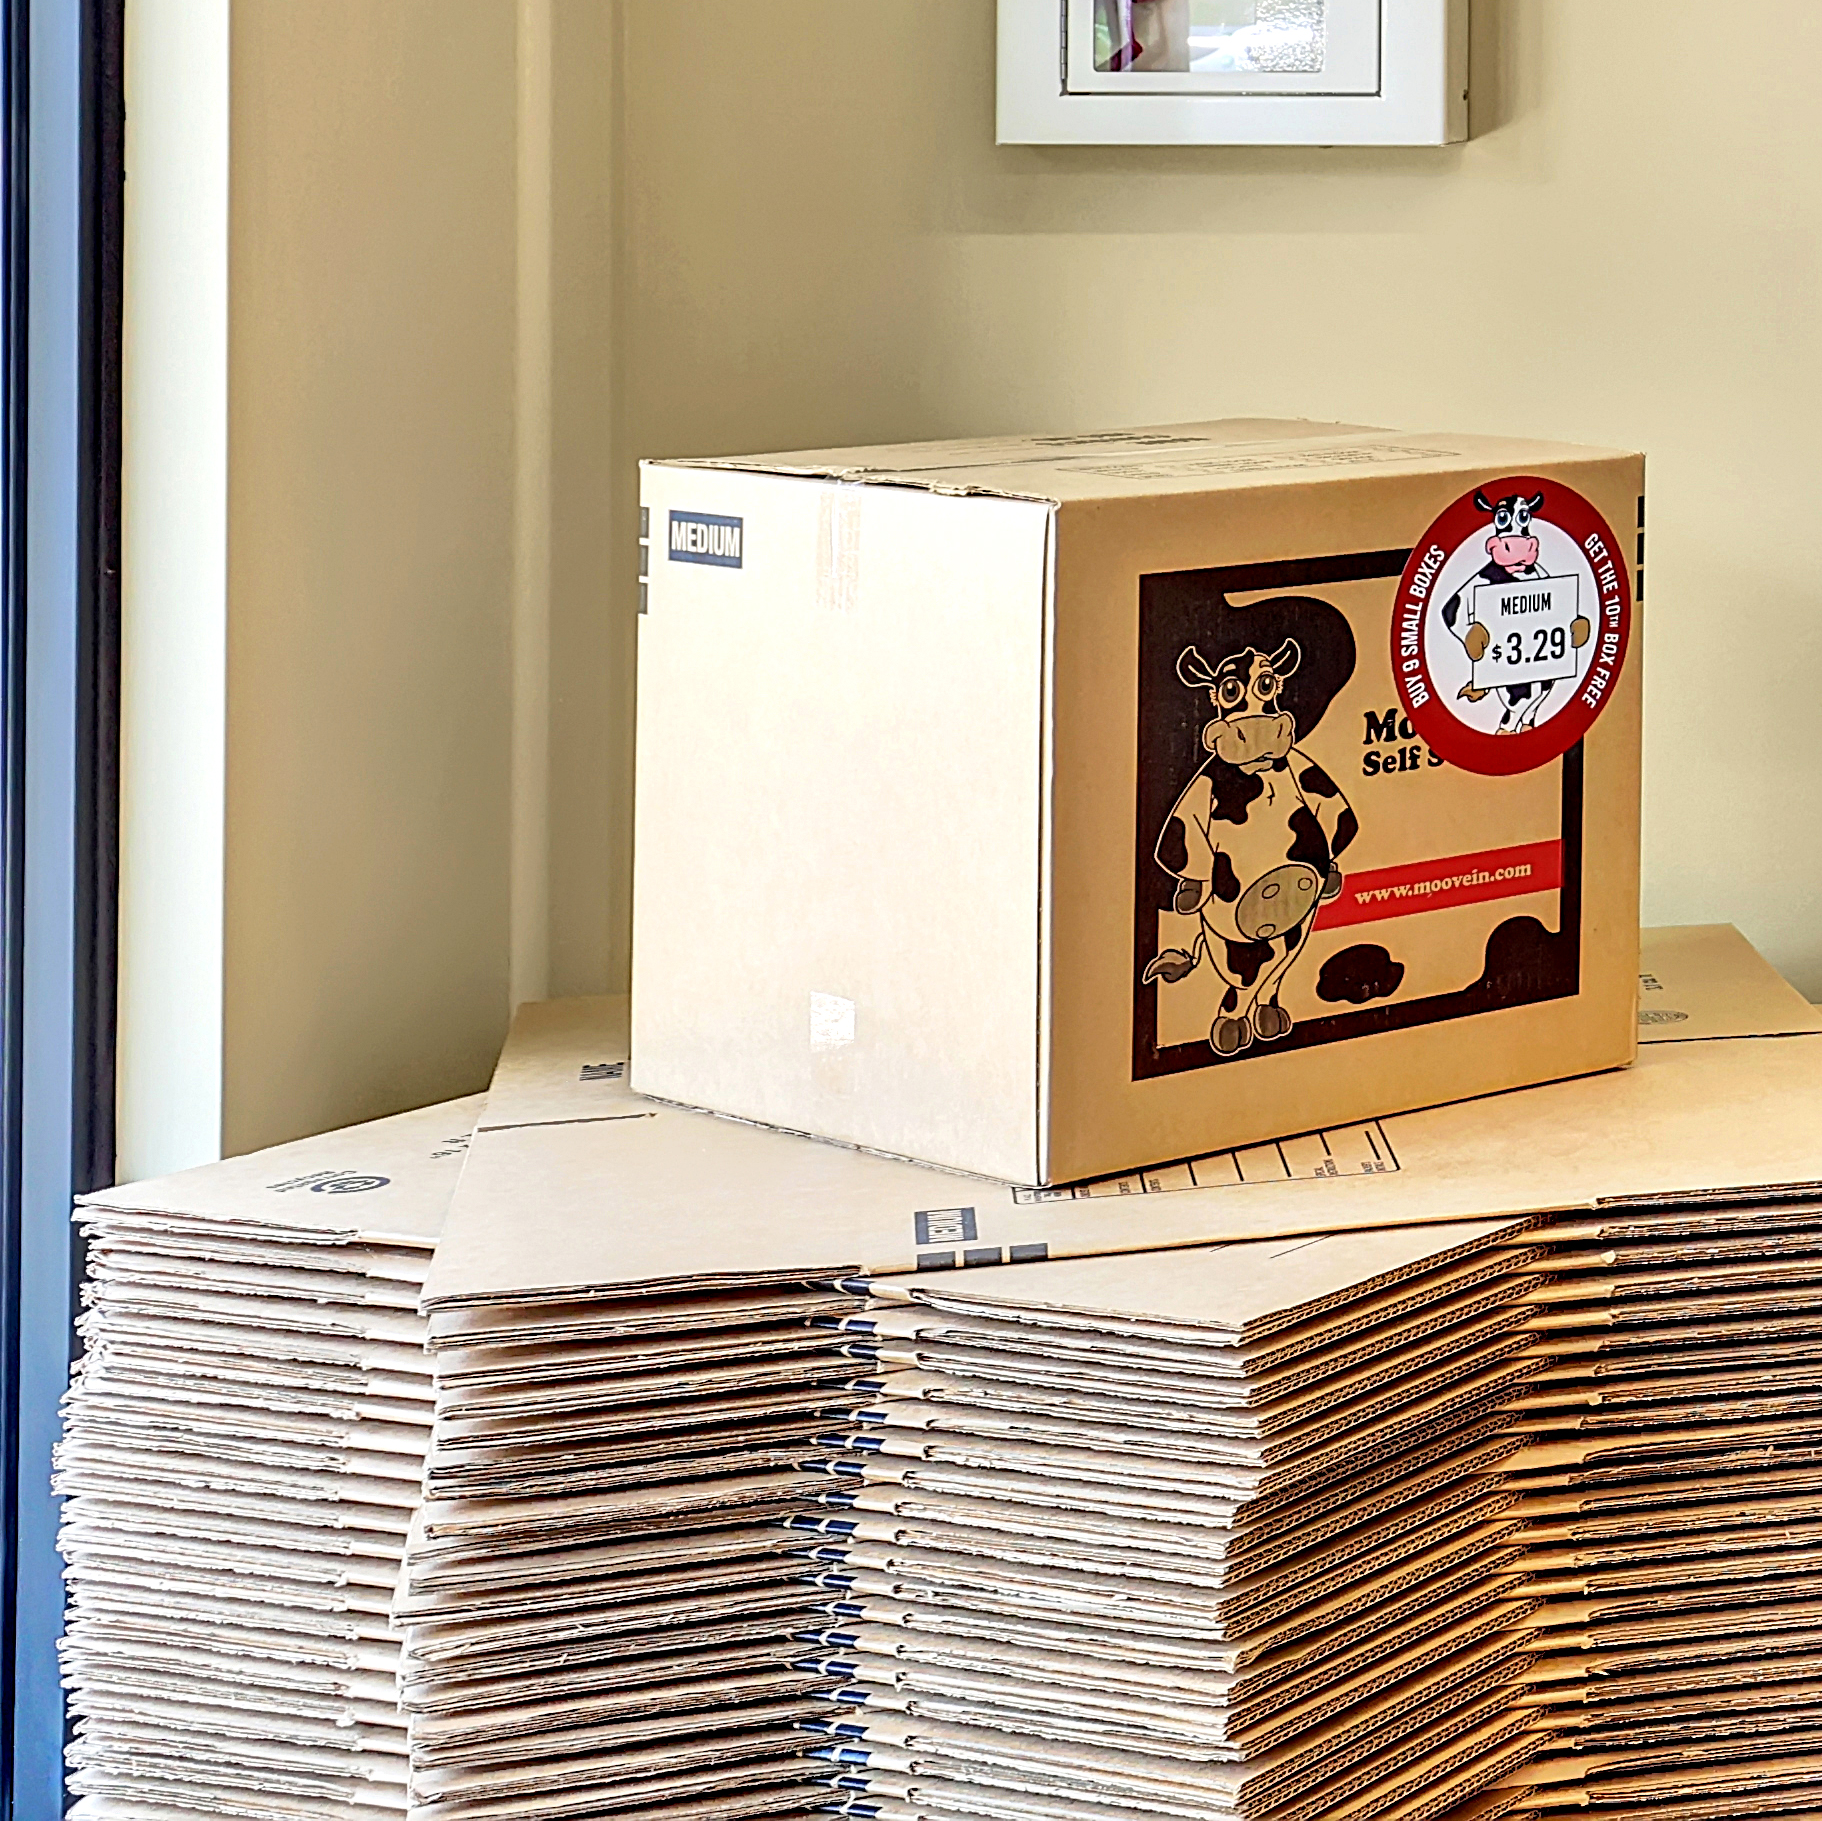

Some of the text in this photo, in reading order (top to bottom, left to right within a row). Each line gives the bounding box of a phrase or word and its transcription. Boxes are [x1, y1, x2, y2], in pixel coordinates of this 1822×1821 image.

[671, 520, 741, 557] MEDIUM
[1584, 532, 1607, 562] GET
[1597, 559, 1618, 593] THE
[1501, 593, 1551, 616] MEDIUM
[1401, 544, 1445, 708] BUY 9 SMALL BOXES
[1492, 627, 1565, 665] $3.29
[1598, 633, 1619, 665] BOX
[1581, 667, 1610, 708] FREE
[1363, 745, 1421, 776] Self
[1355, 862, 1532, 906] www.moovein.com
